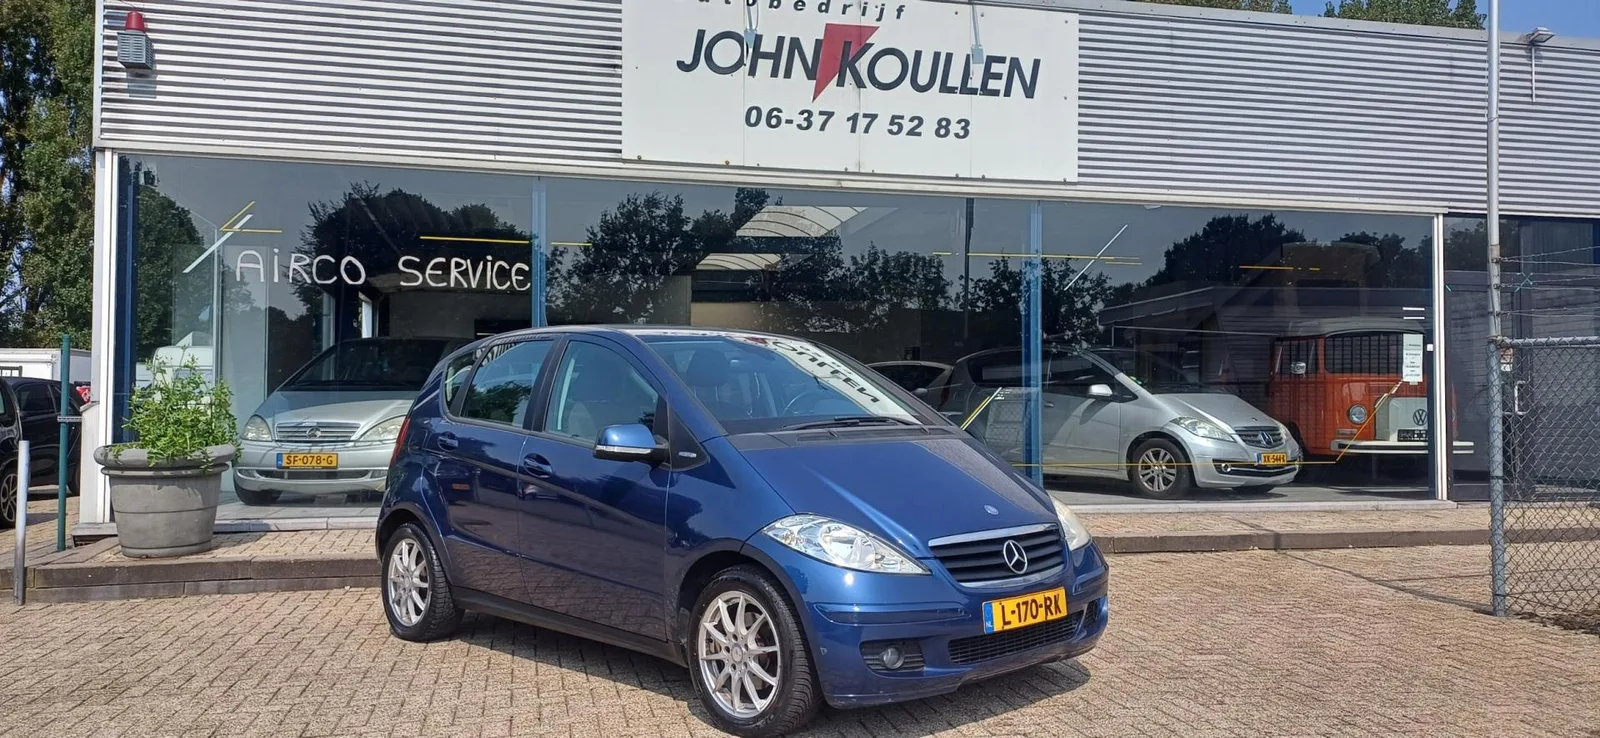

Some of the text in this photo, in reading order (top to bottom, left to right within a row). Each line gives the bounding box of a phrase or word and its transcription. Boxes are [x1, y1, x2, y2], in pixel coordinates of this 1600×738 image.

[676, 28, 1042, 99] JOHN KOULLEN
[744, 105, 971, 140] 06-37 17 52 83
[286, 455, 333, 465] SF-078-G
[1001, 594, 1062, 627] L-170-RK
